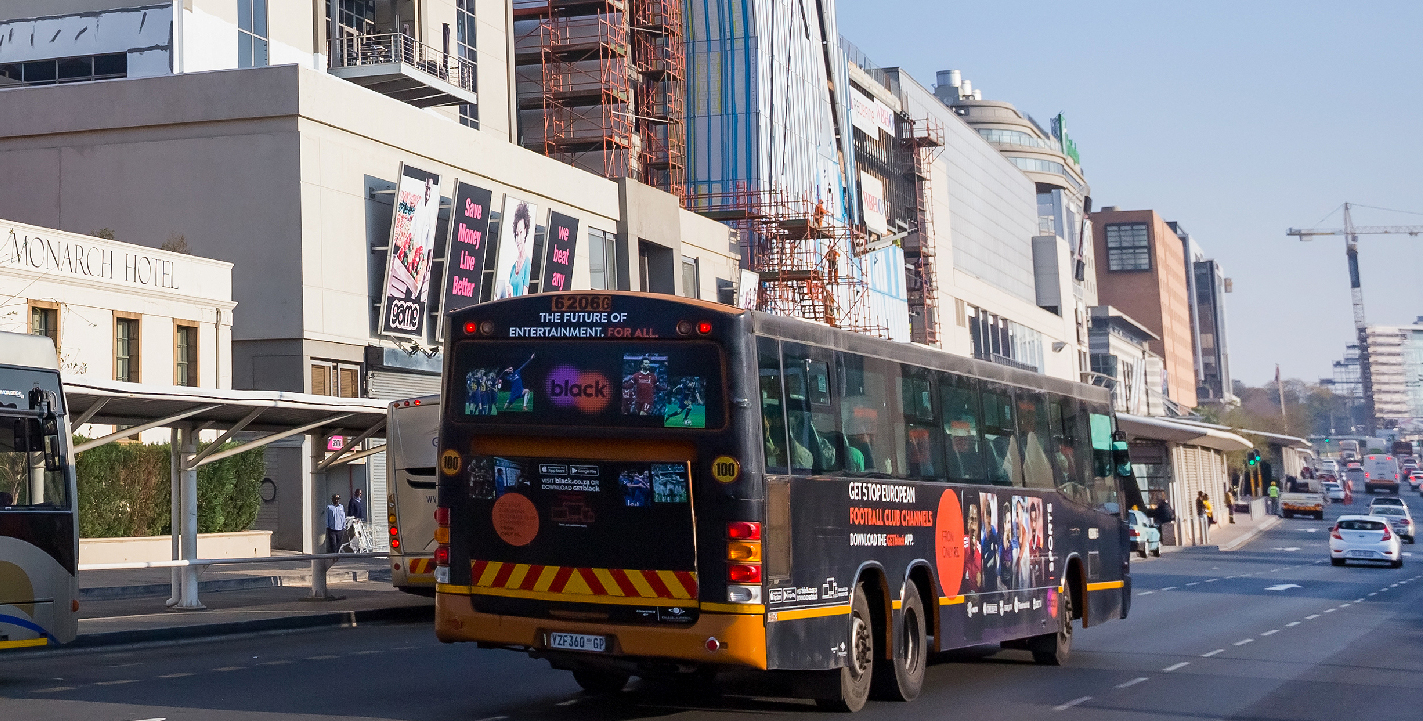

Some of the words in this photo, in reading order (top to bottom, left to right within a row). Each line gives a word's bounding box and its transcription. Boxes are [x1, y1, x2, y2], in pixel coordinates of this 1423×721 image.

[465, 198, 482, 219] Save
[457, 223, 481, 250] Money
[558, 225, 569, 241] we
[11, 230, 112, 279] MONARCH
[125, 253, 179, 289] HOTEL
[459, 250, 475, 271] Live
[552, 244, 569, 266] beat
[452, 276, 475, 298] Better
[551, 272, 565, 292] any
[539, 312, 561, 323] THE
[563, 312, 608, 323] FUTURE
[610, 312, 628, 324] OF
[509, 326, 605, 337] ENTERTAINMENT.
[607, 327, 631, 338] FOR
[634, 327, 659, 338] ALL.
[550, 379, 606, 399] black
[444, 456, 459, 470] 100
[716, 462, 735, 477] 100
[849, 482, 862, 500] GET
[862, 483, 867, 501] 5
[867, 483, 881, 501] TOP
[882, 485, 916, 503] EUROPEAN
[849, 507, 883, 526] FOOTBALL
[884, 509, 901, 526] CLUB
[901, 510, 933, 527] CHANNELS
[849, 533, 877, 546] DOWNLOAD
